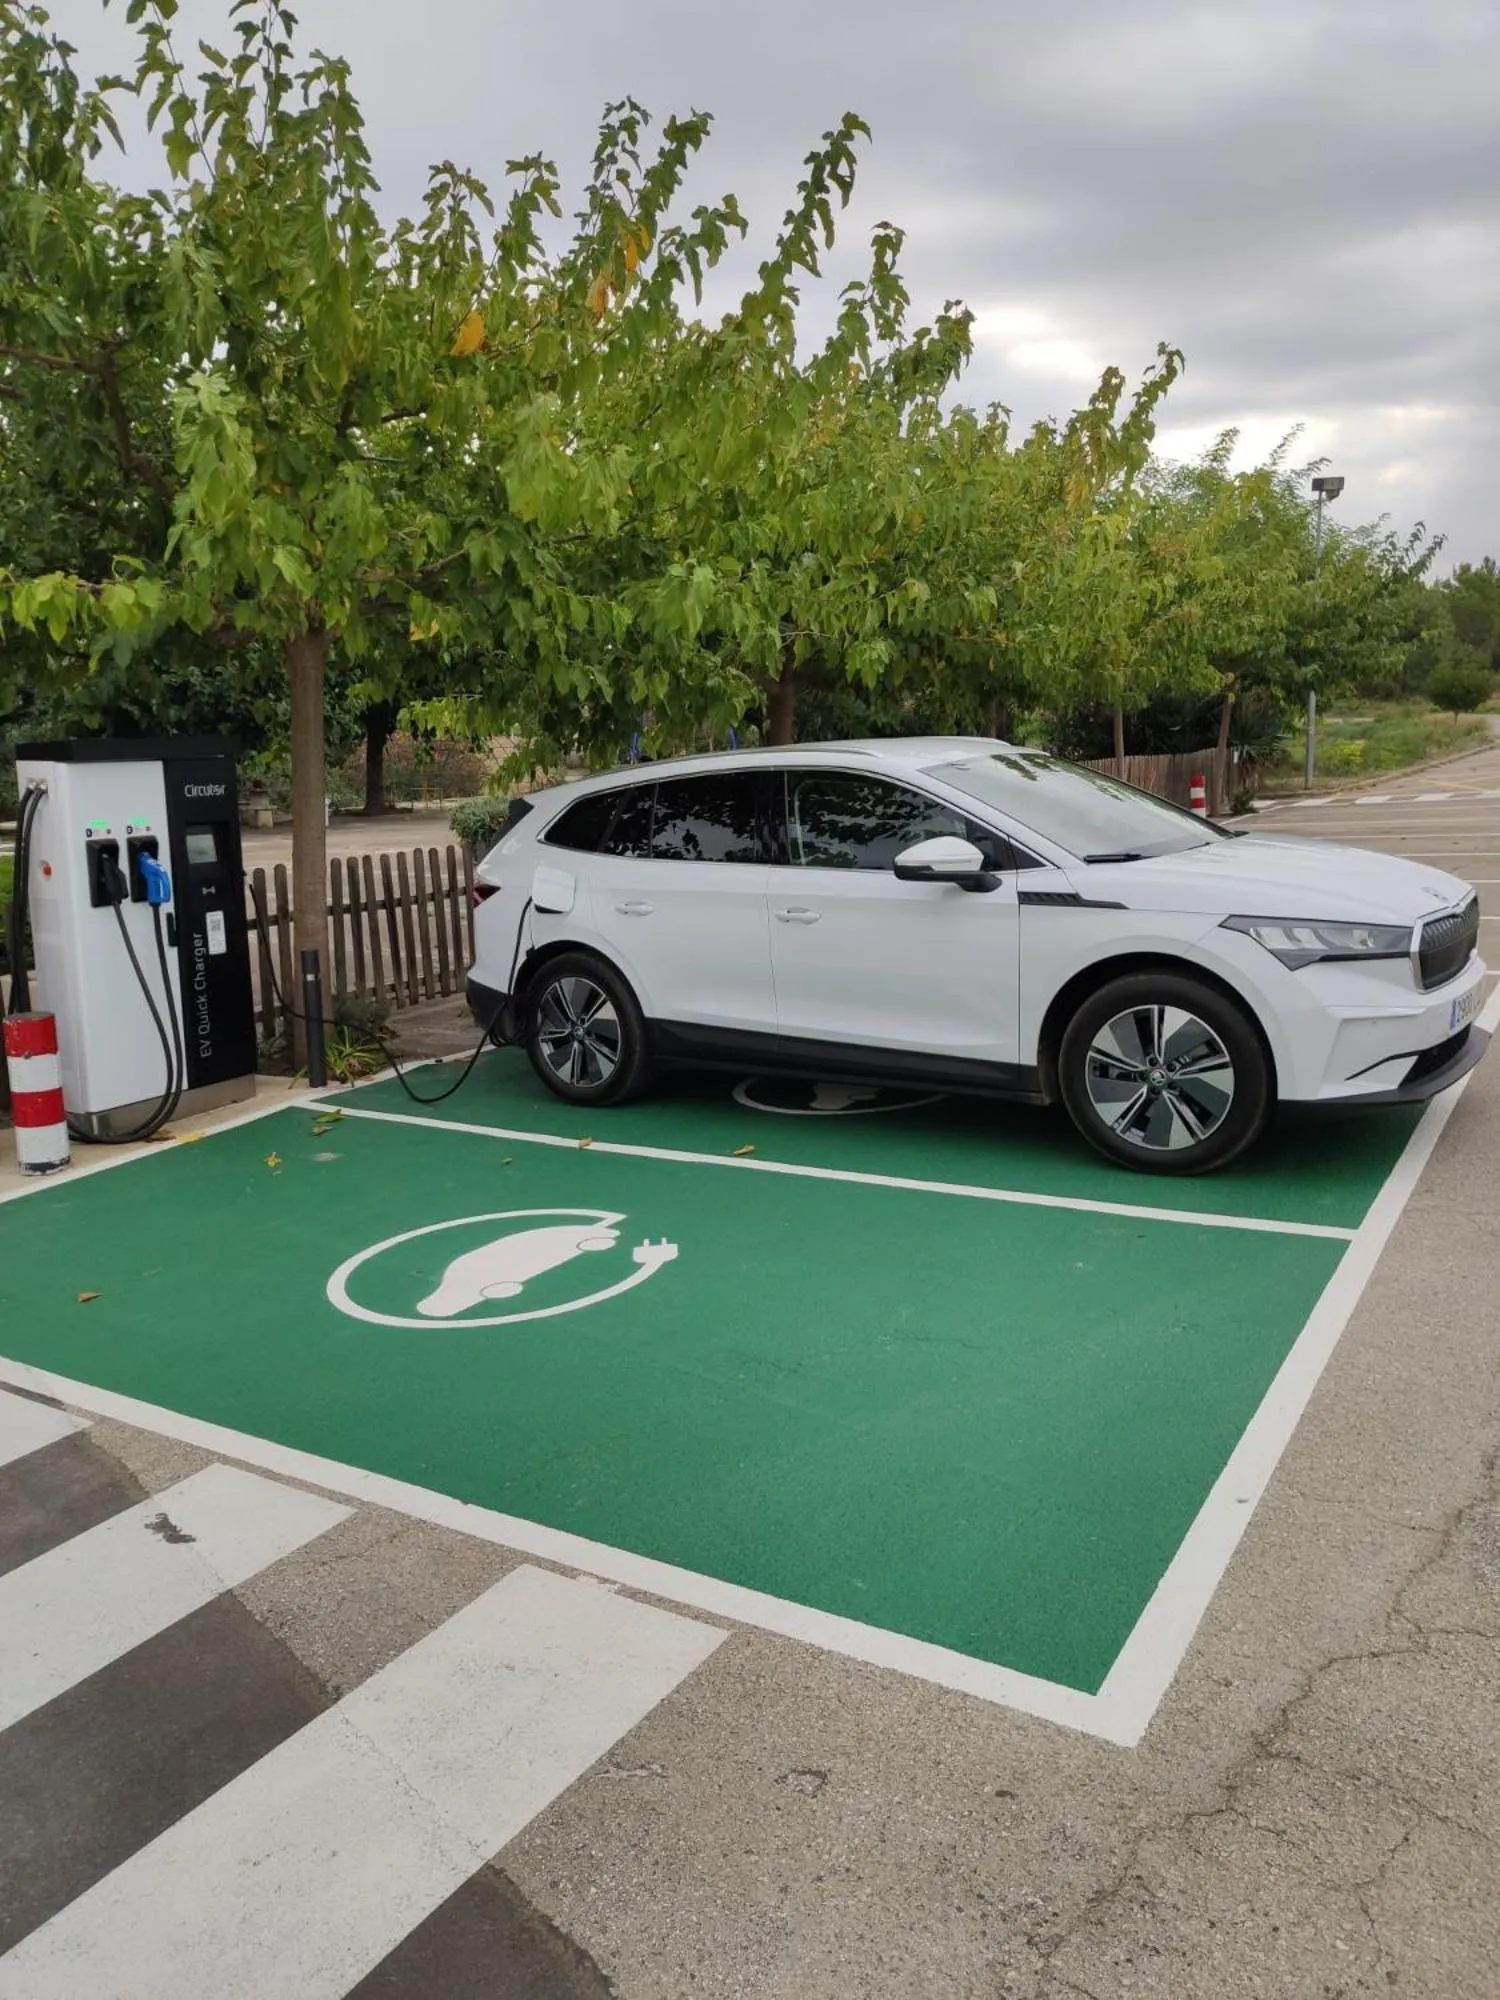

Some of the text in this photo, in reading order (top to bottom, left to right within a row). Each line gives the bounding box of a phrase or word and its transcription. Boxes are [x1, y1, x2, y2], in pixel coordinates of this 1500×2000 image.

[193, 933, 212, 1058] EV Quick Charger
